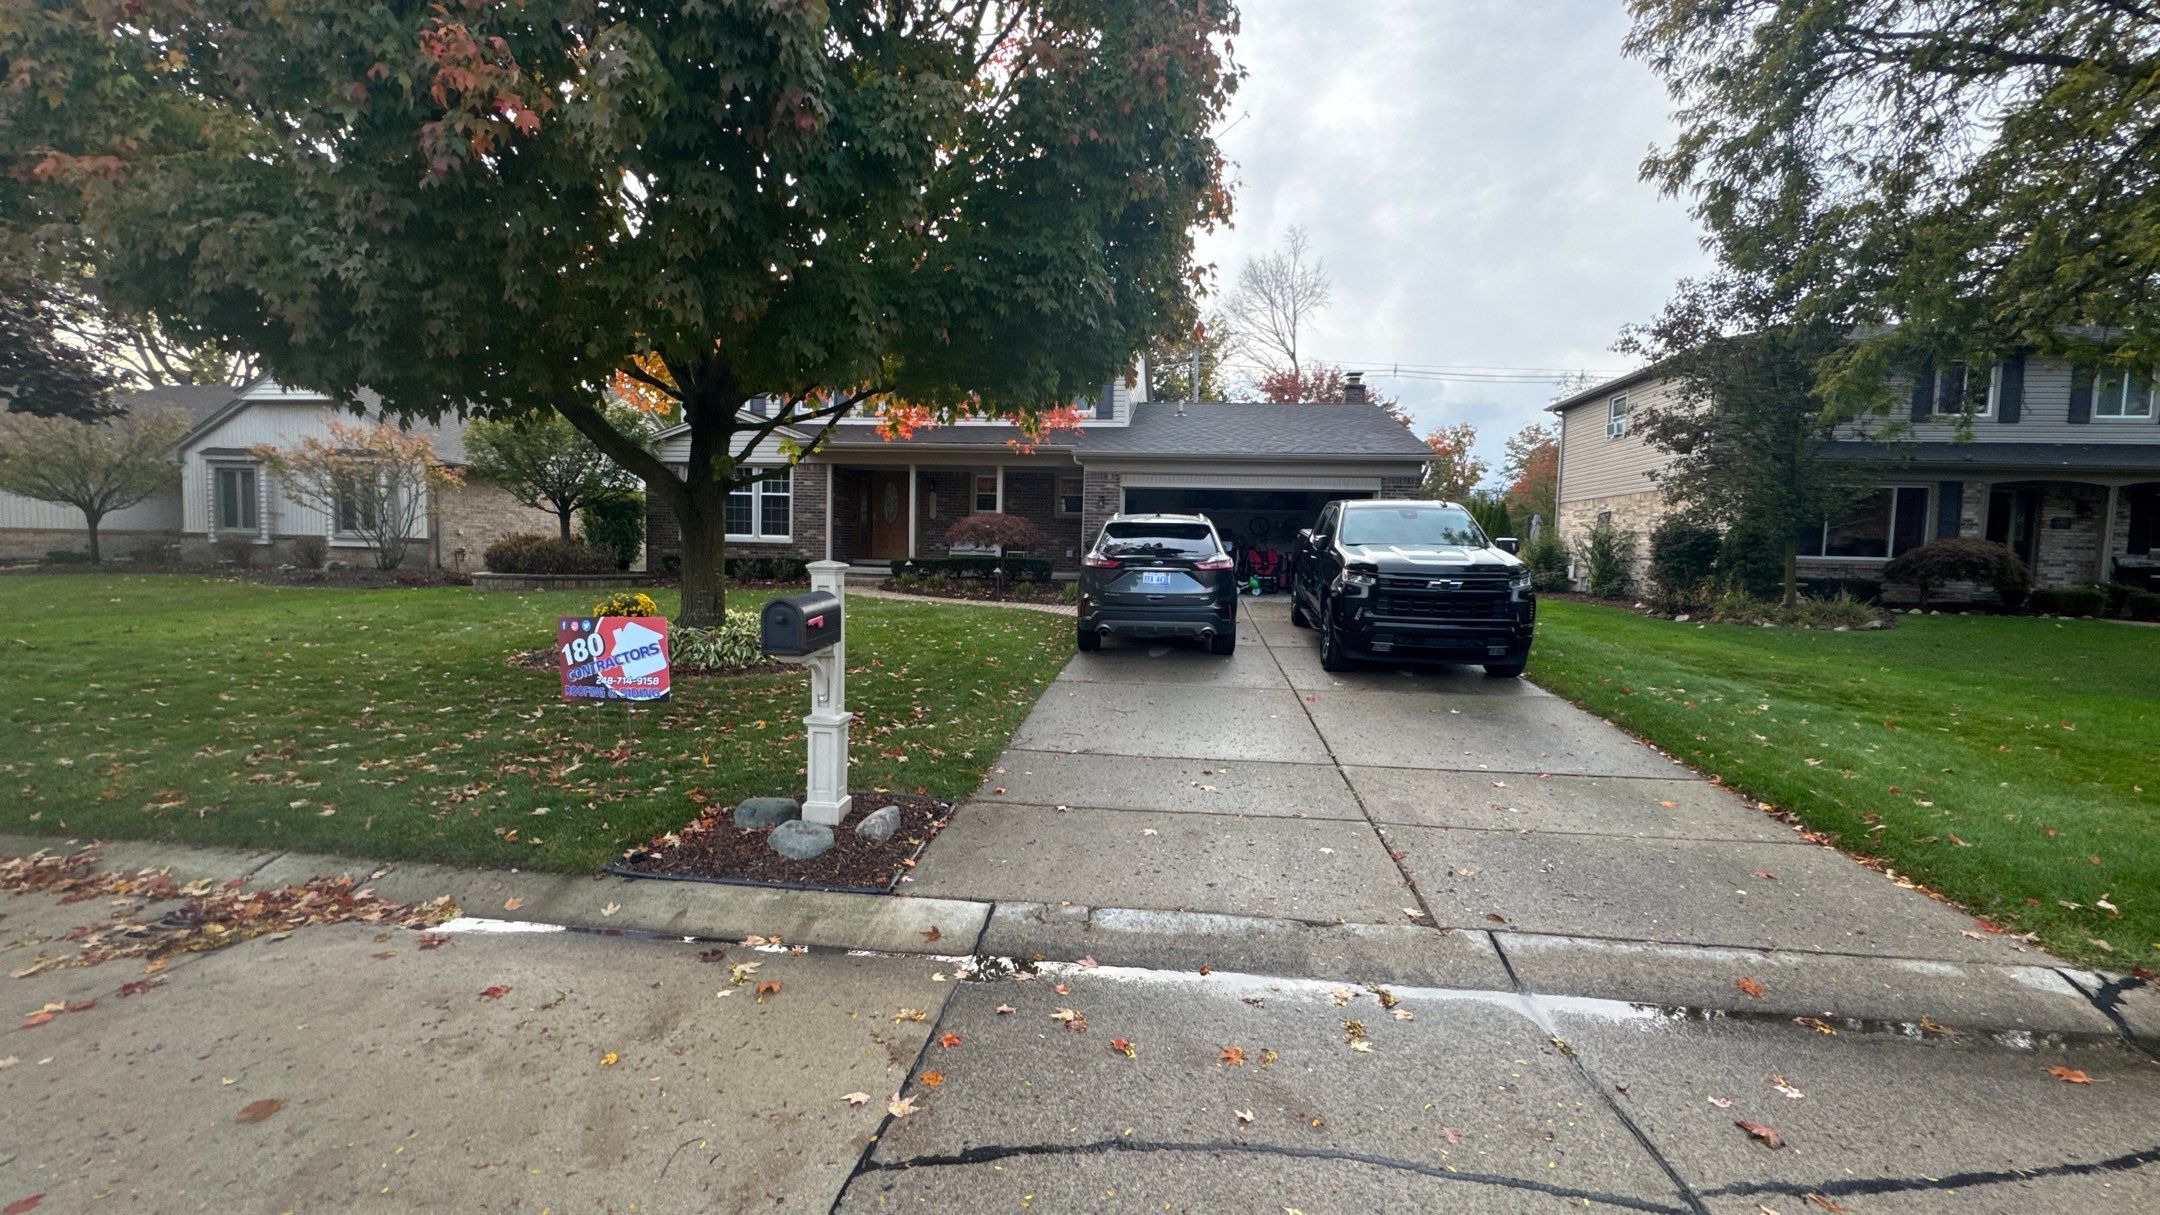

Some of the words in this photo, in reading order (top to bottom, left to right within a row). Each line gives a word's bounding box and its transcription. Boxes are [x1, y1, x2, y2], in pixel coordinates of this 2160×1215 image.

[561, 633, 604, 666] 180
[567, 642, 660, 681] CONTRACTORS
[564, 685, 606, 698] ROOFING
[608, 688, 617, 698] &
[620, 688, 661, 699] SIDING
[596, 676, 660, 685] 248-714-9158
